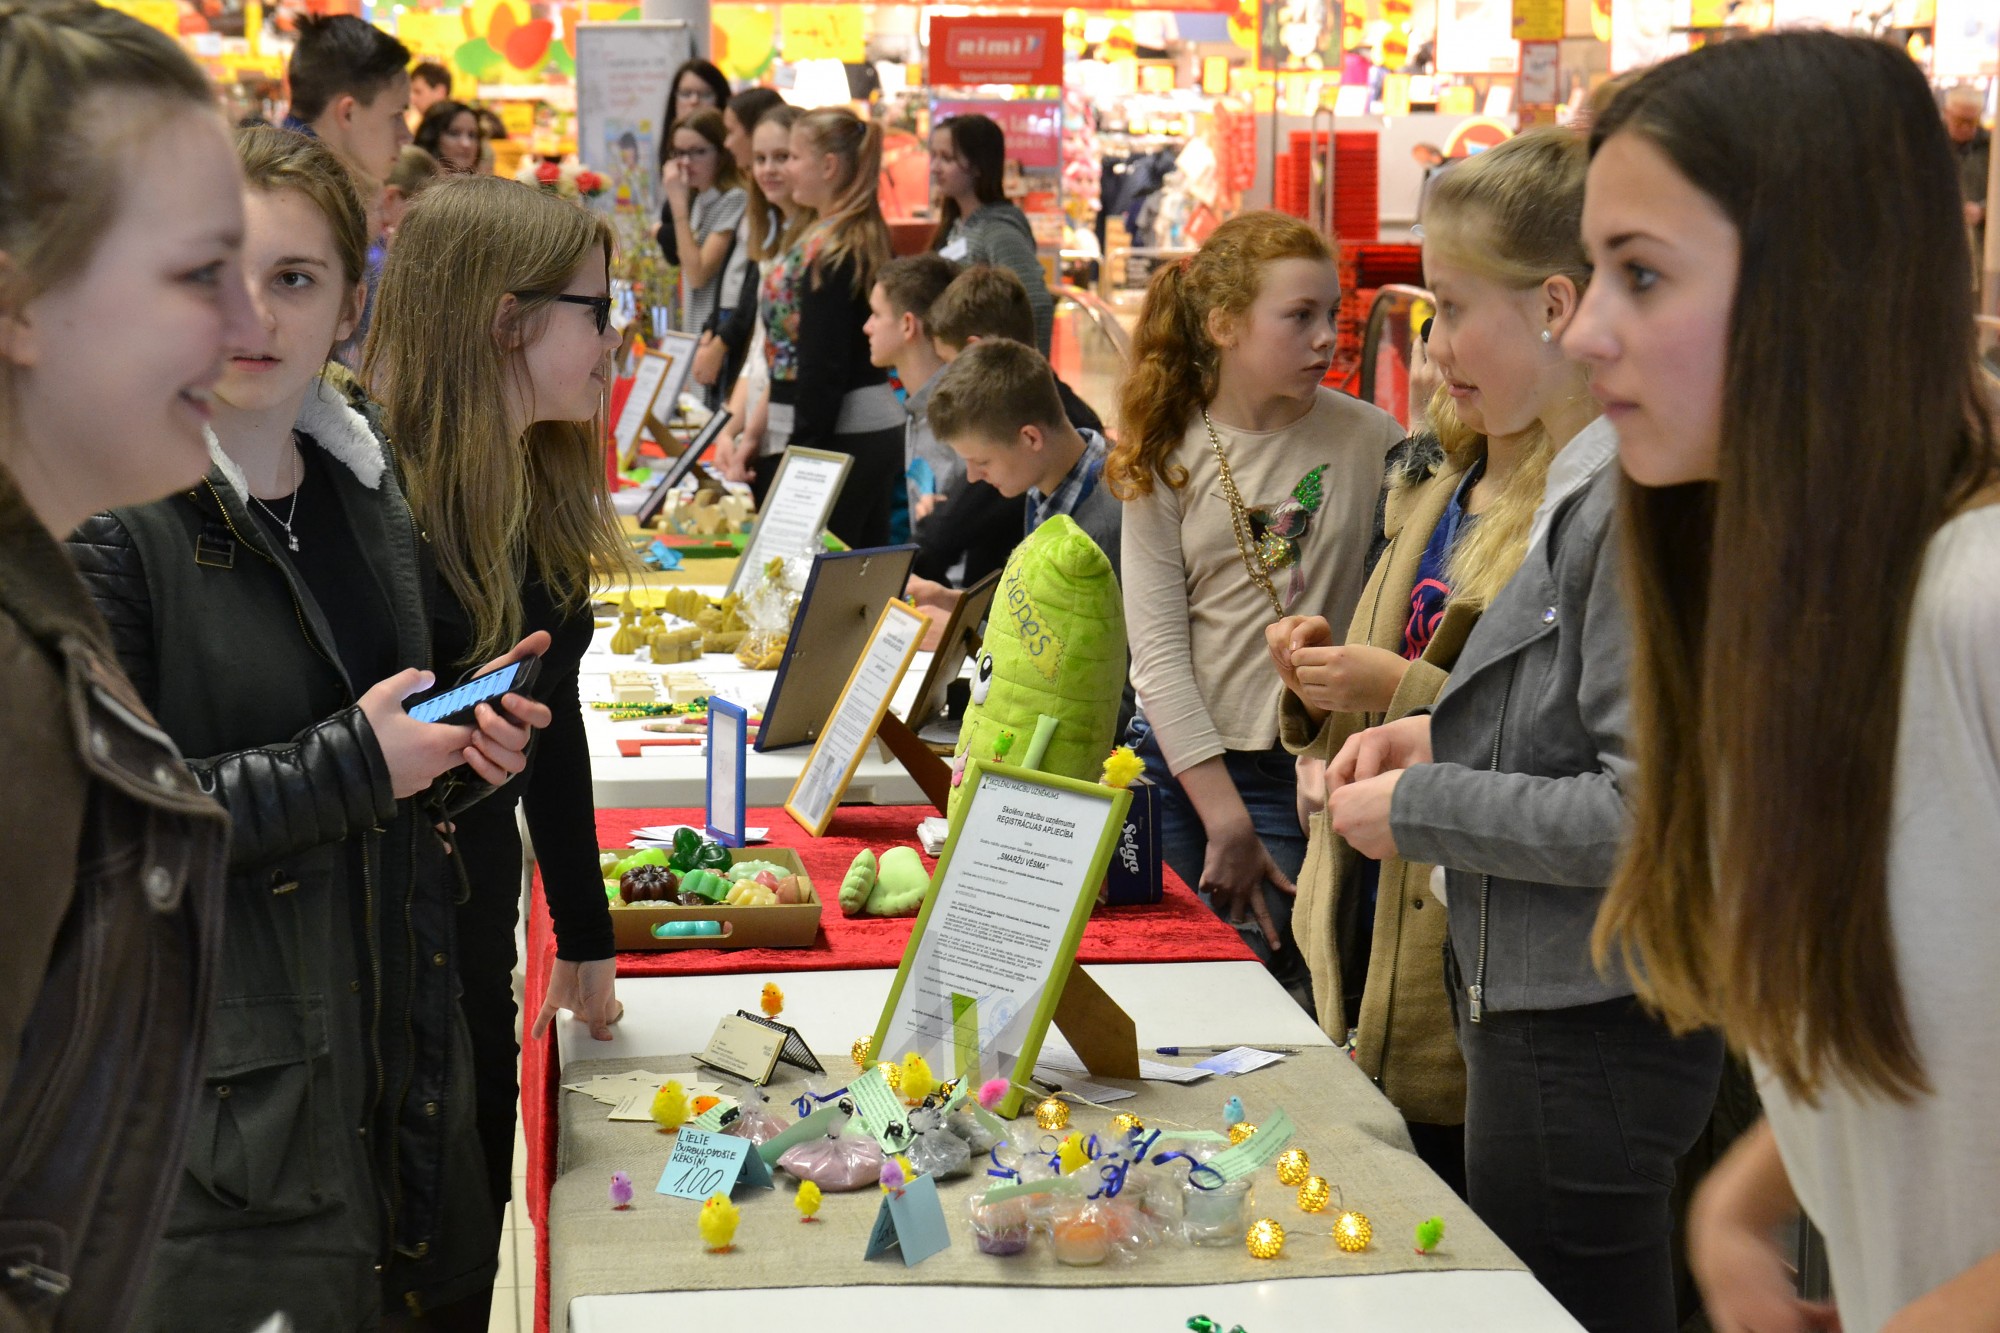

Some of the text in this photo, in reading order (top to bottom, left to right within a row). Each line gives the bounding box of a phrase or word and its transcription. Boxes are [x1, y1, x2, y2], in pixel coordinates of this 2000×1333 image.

[1002, 805, 1024, 817] Skolēnu
[1119, 820, 1140, 875] Selga
[673, 1167, 724, 1195] 1.00
